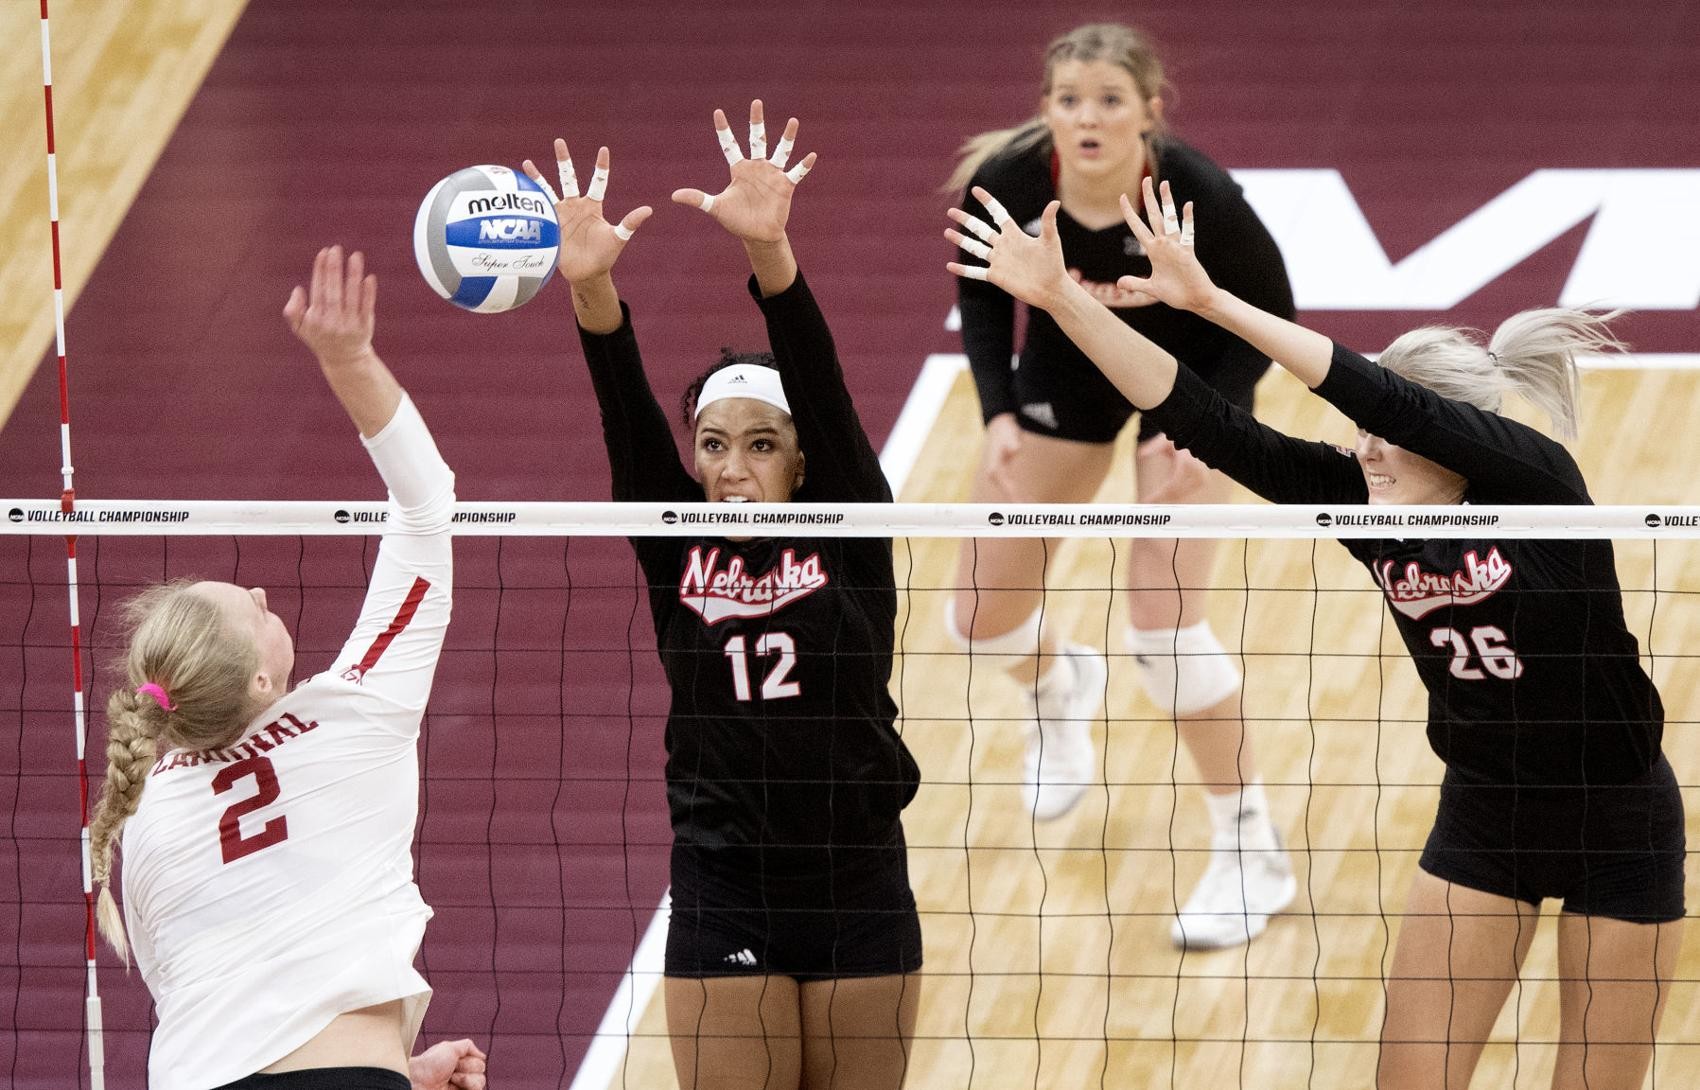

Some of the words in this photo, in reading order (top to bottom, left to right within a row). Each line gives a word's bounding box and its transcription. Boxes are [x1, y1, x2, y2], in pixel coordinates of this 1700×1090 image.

[468, 193, 545, 214] molten
[479, 219, 542, 241] NCAA
[472, 253, 509, 271] Super
[513, 254, 545, 269] Touch
[27, 510, 96, 522] VOLLEYBALL
[98, 511, 190, 522] CHAMPIONSHIP
[353, 511, 389, 523] VOLLE
[451, 512, 517, 523] MPIONSHIP
[680, 512, 750, 523] VOLLEYBALL
[752, 513, 844, 524] CHAMPIONSHIP
[1007, 514, 1076, 524] VOLLEYBALL
[1079, 514, 1171, 524] CHAMPIONSHIP
[1335, 515, 1404, 525] VOLLEYBALL
[1407, 515, 1499, 525] CHAMPIONSHIP
[1664, 515, 1700, 526] VOLLE
[680, 546, 829, 606] Nebraska
[1373, 546, 1512, 602] Nebraska
[1430, 625, 1524, 680] 26
[724, 631, 801, 702] 12
[211, 756, 289, 865] 2
